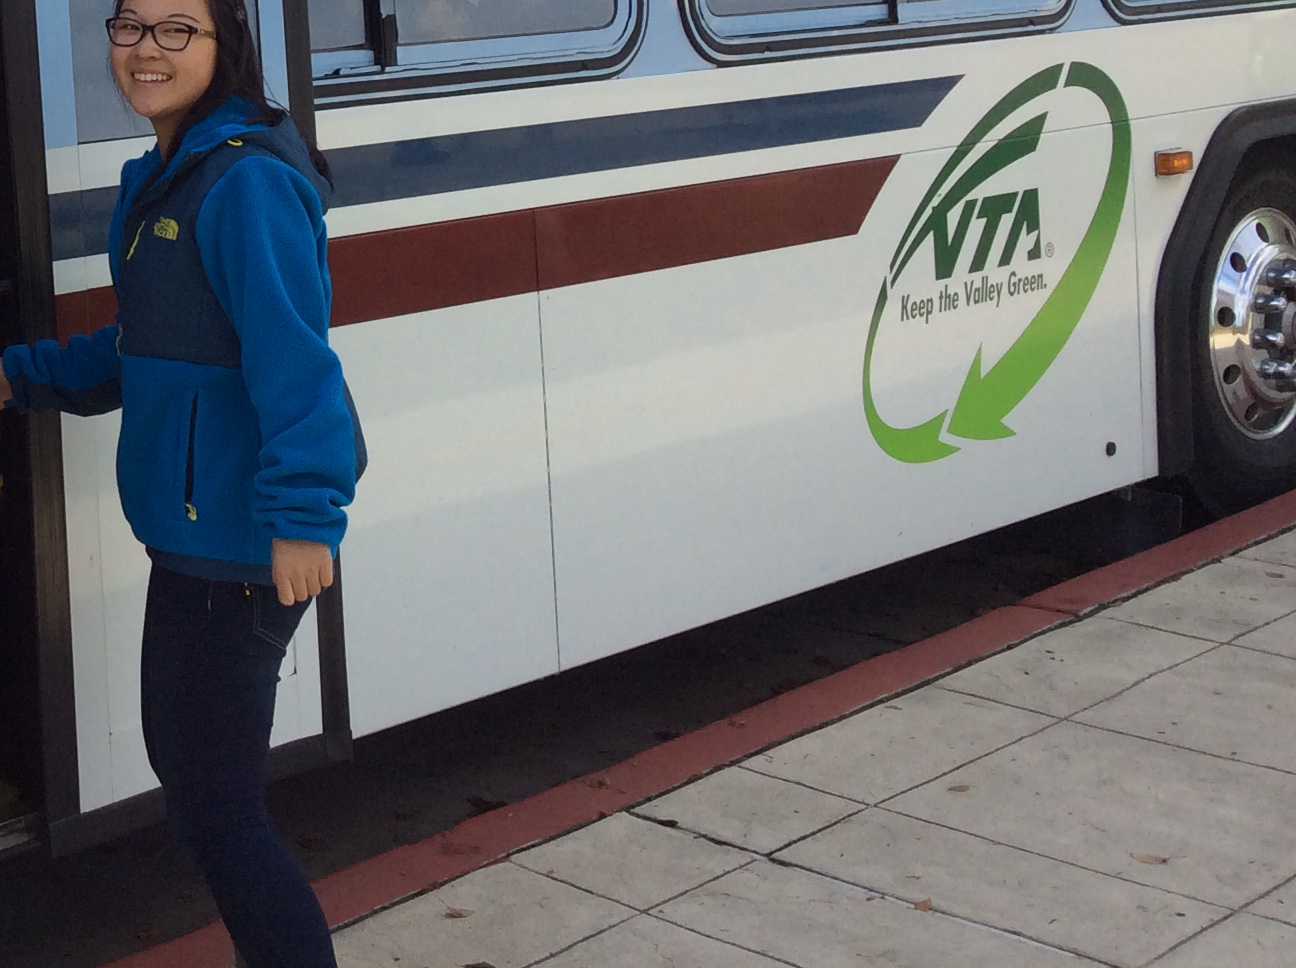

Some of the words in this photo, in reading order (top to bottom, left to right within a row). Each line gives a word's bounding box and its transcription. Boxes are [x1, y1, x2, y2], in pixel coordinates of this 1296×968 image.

[931, 187, 1042, 282] VTA
[900, 293, 935, 325] Keep
[938, 283, 960, 313] the
[963, 274, 1004, 308] Valley
[1007, 270, 1048, 297] Green.
